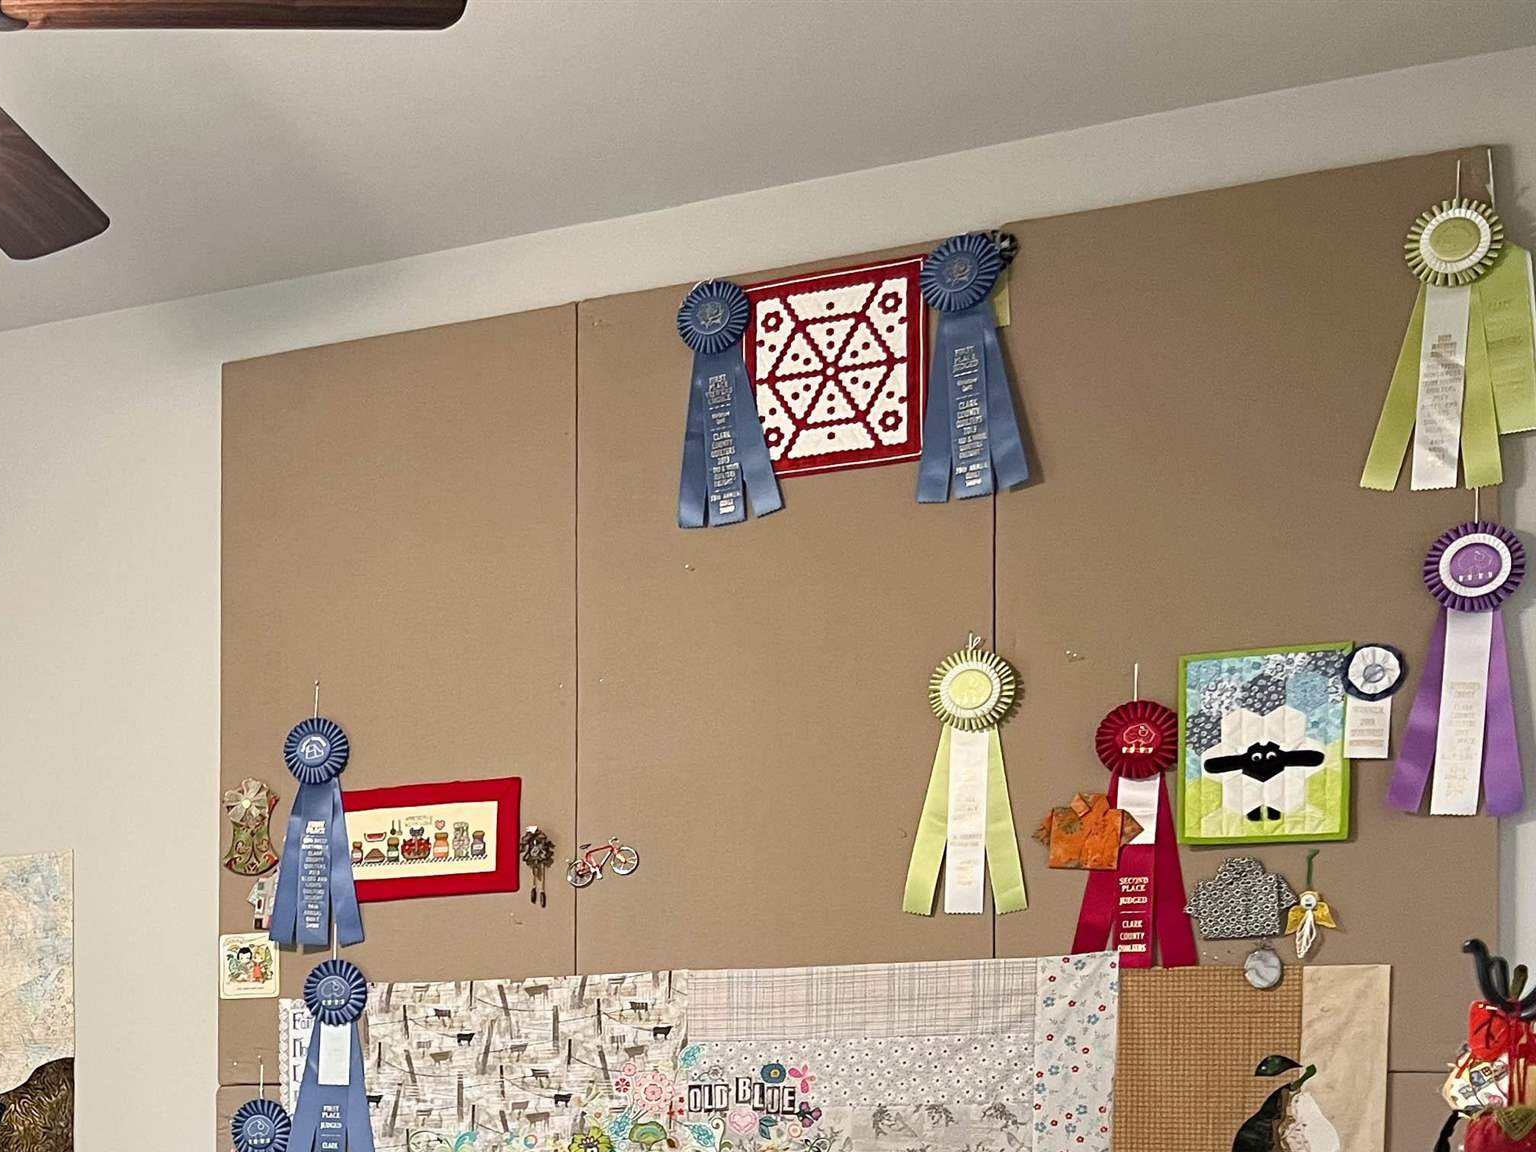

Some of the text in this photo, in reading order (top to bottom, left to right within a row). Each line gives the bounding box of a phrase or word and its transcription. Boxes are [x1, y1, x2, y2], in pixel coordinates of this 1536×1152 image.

[1119, 877, 1149, 885] SECOND
[1121, 884, 1146, 892] PLACE
[1119, 896, 1148, 905] JUDGED
[1122, 920, 1143, 928] CLARK
[1120, 932, 1145, 941] COUNTY
[688, 1076, 796, 1115] OLD BLUE
